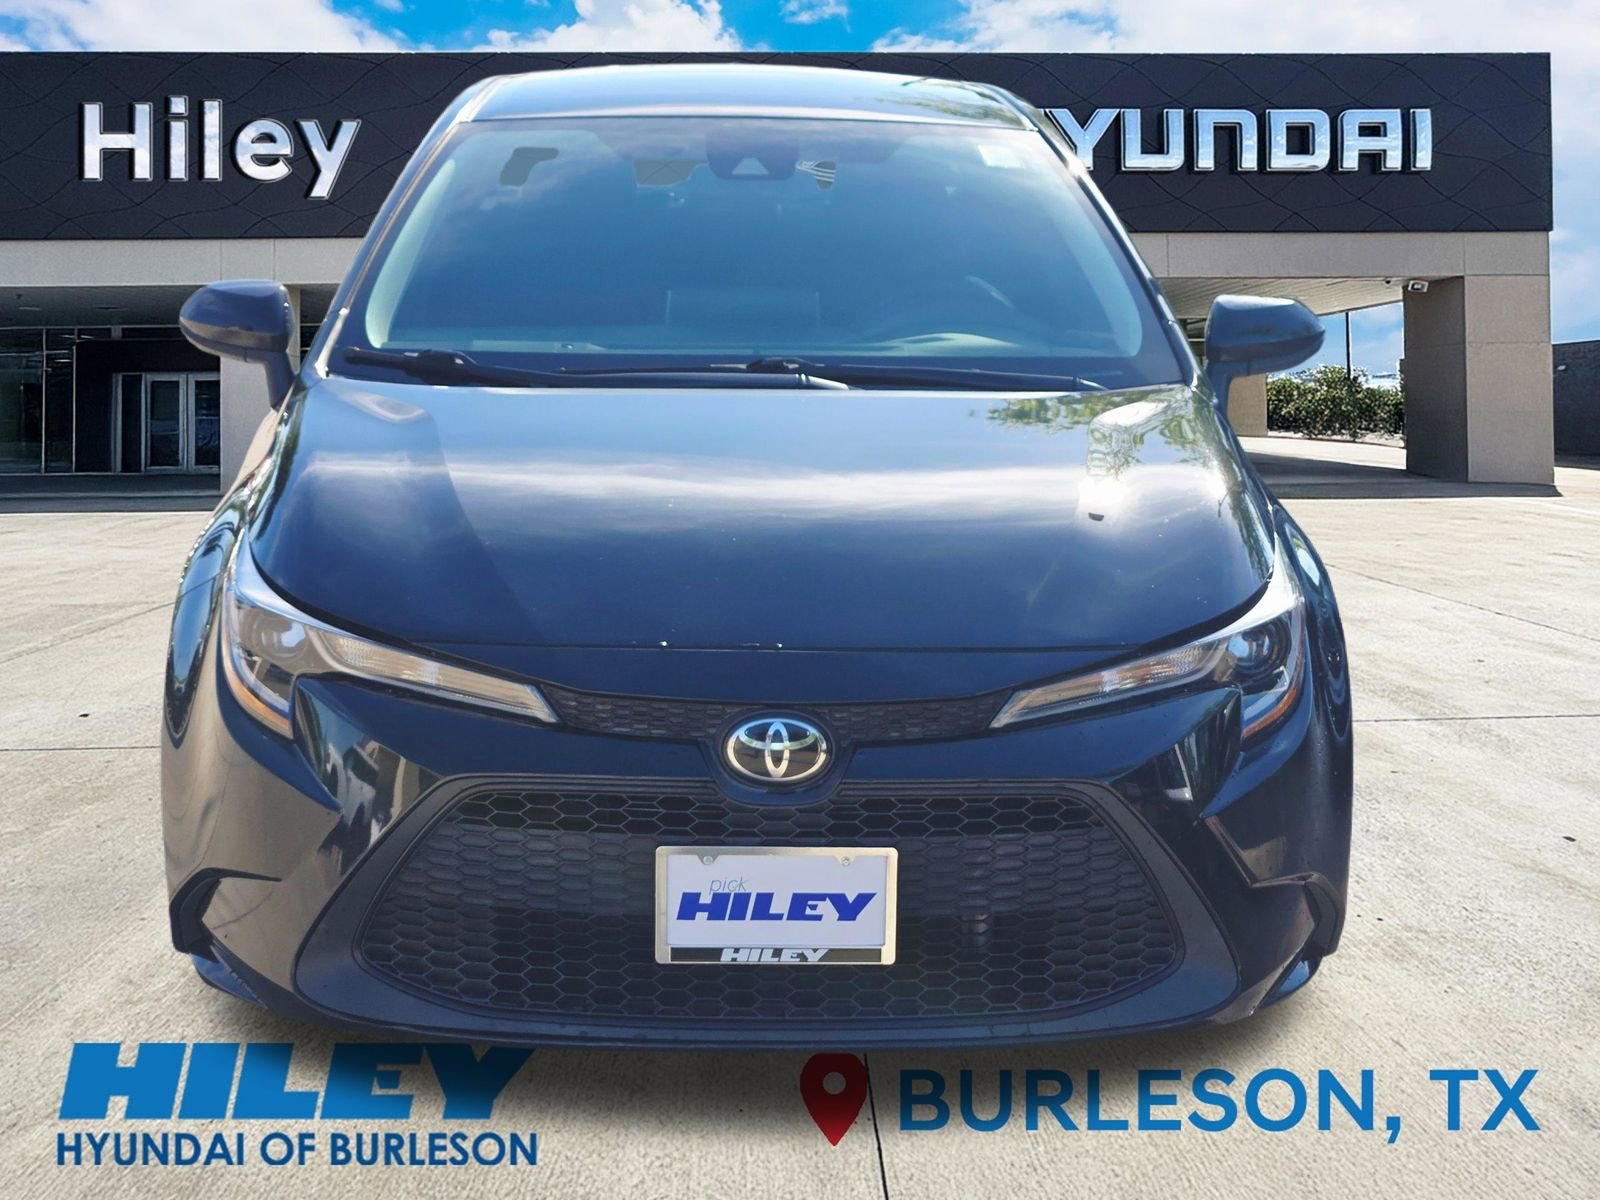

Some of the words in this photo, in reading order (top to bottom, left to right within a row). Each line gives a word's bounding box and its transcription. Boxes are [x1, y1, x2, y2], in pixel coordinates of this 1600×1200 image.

[80, 95, 361, 200] Hiley
[1037, 107, 1433, 172] YUNDAI
[709, 877, 748, 893] pick
[676, 892, 878, 921] HILEY
[720, 949, 830, 962] HILEY
